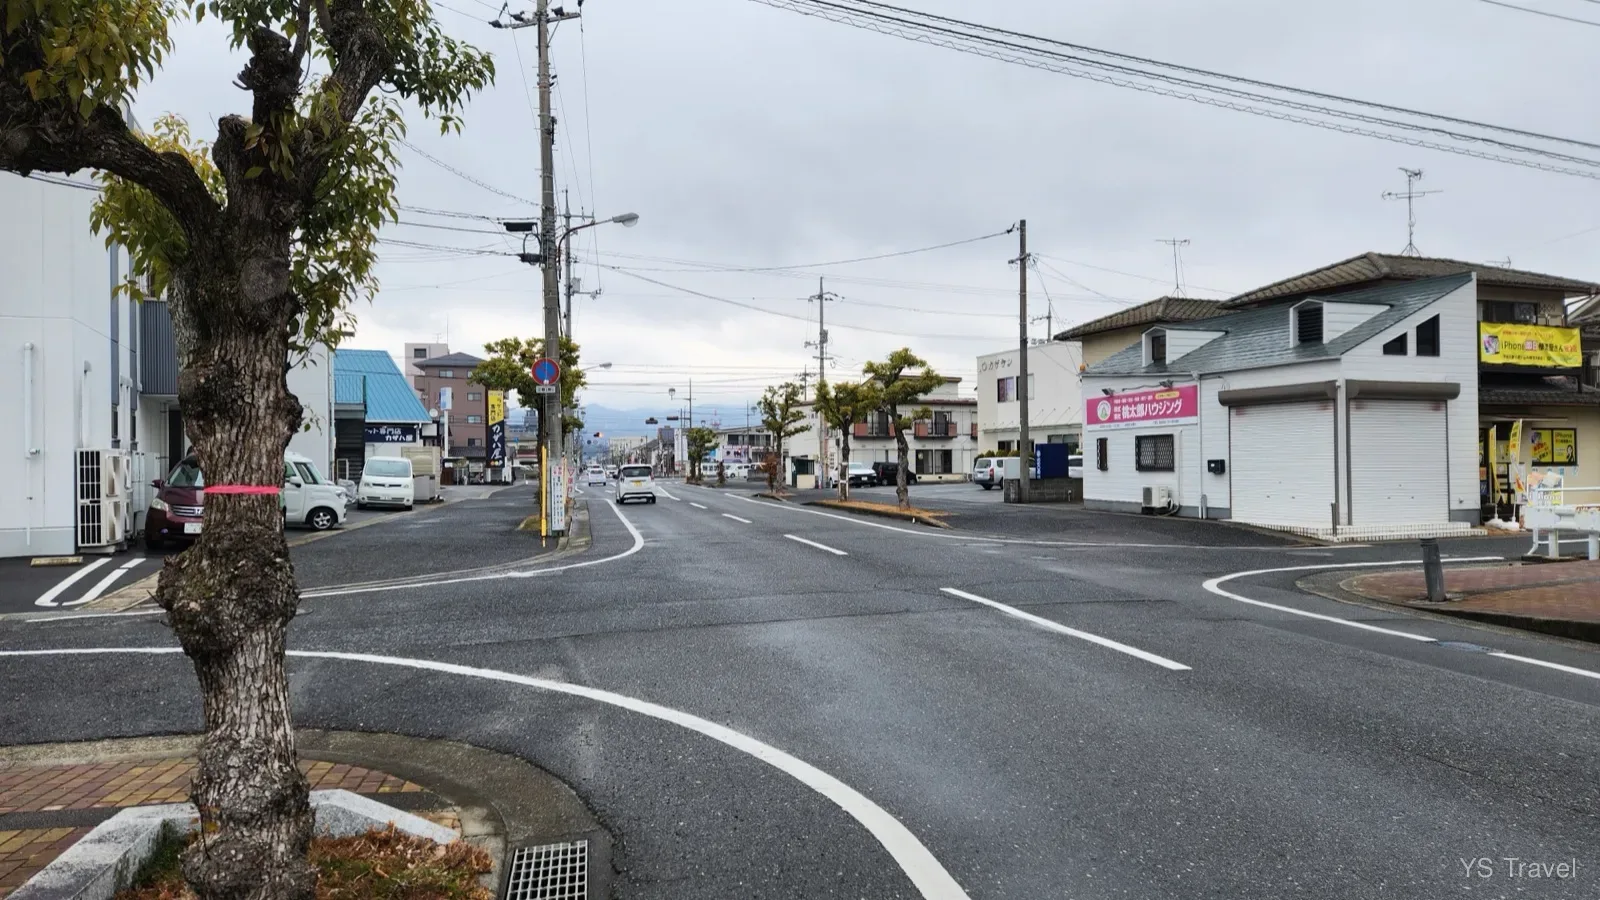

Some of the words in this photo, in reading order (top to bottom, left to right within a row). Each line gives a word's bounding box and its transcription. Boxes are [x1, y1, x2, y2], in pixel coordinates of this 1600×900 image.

[1121, 398, 1183, 420] 桃太郎ハウジング
